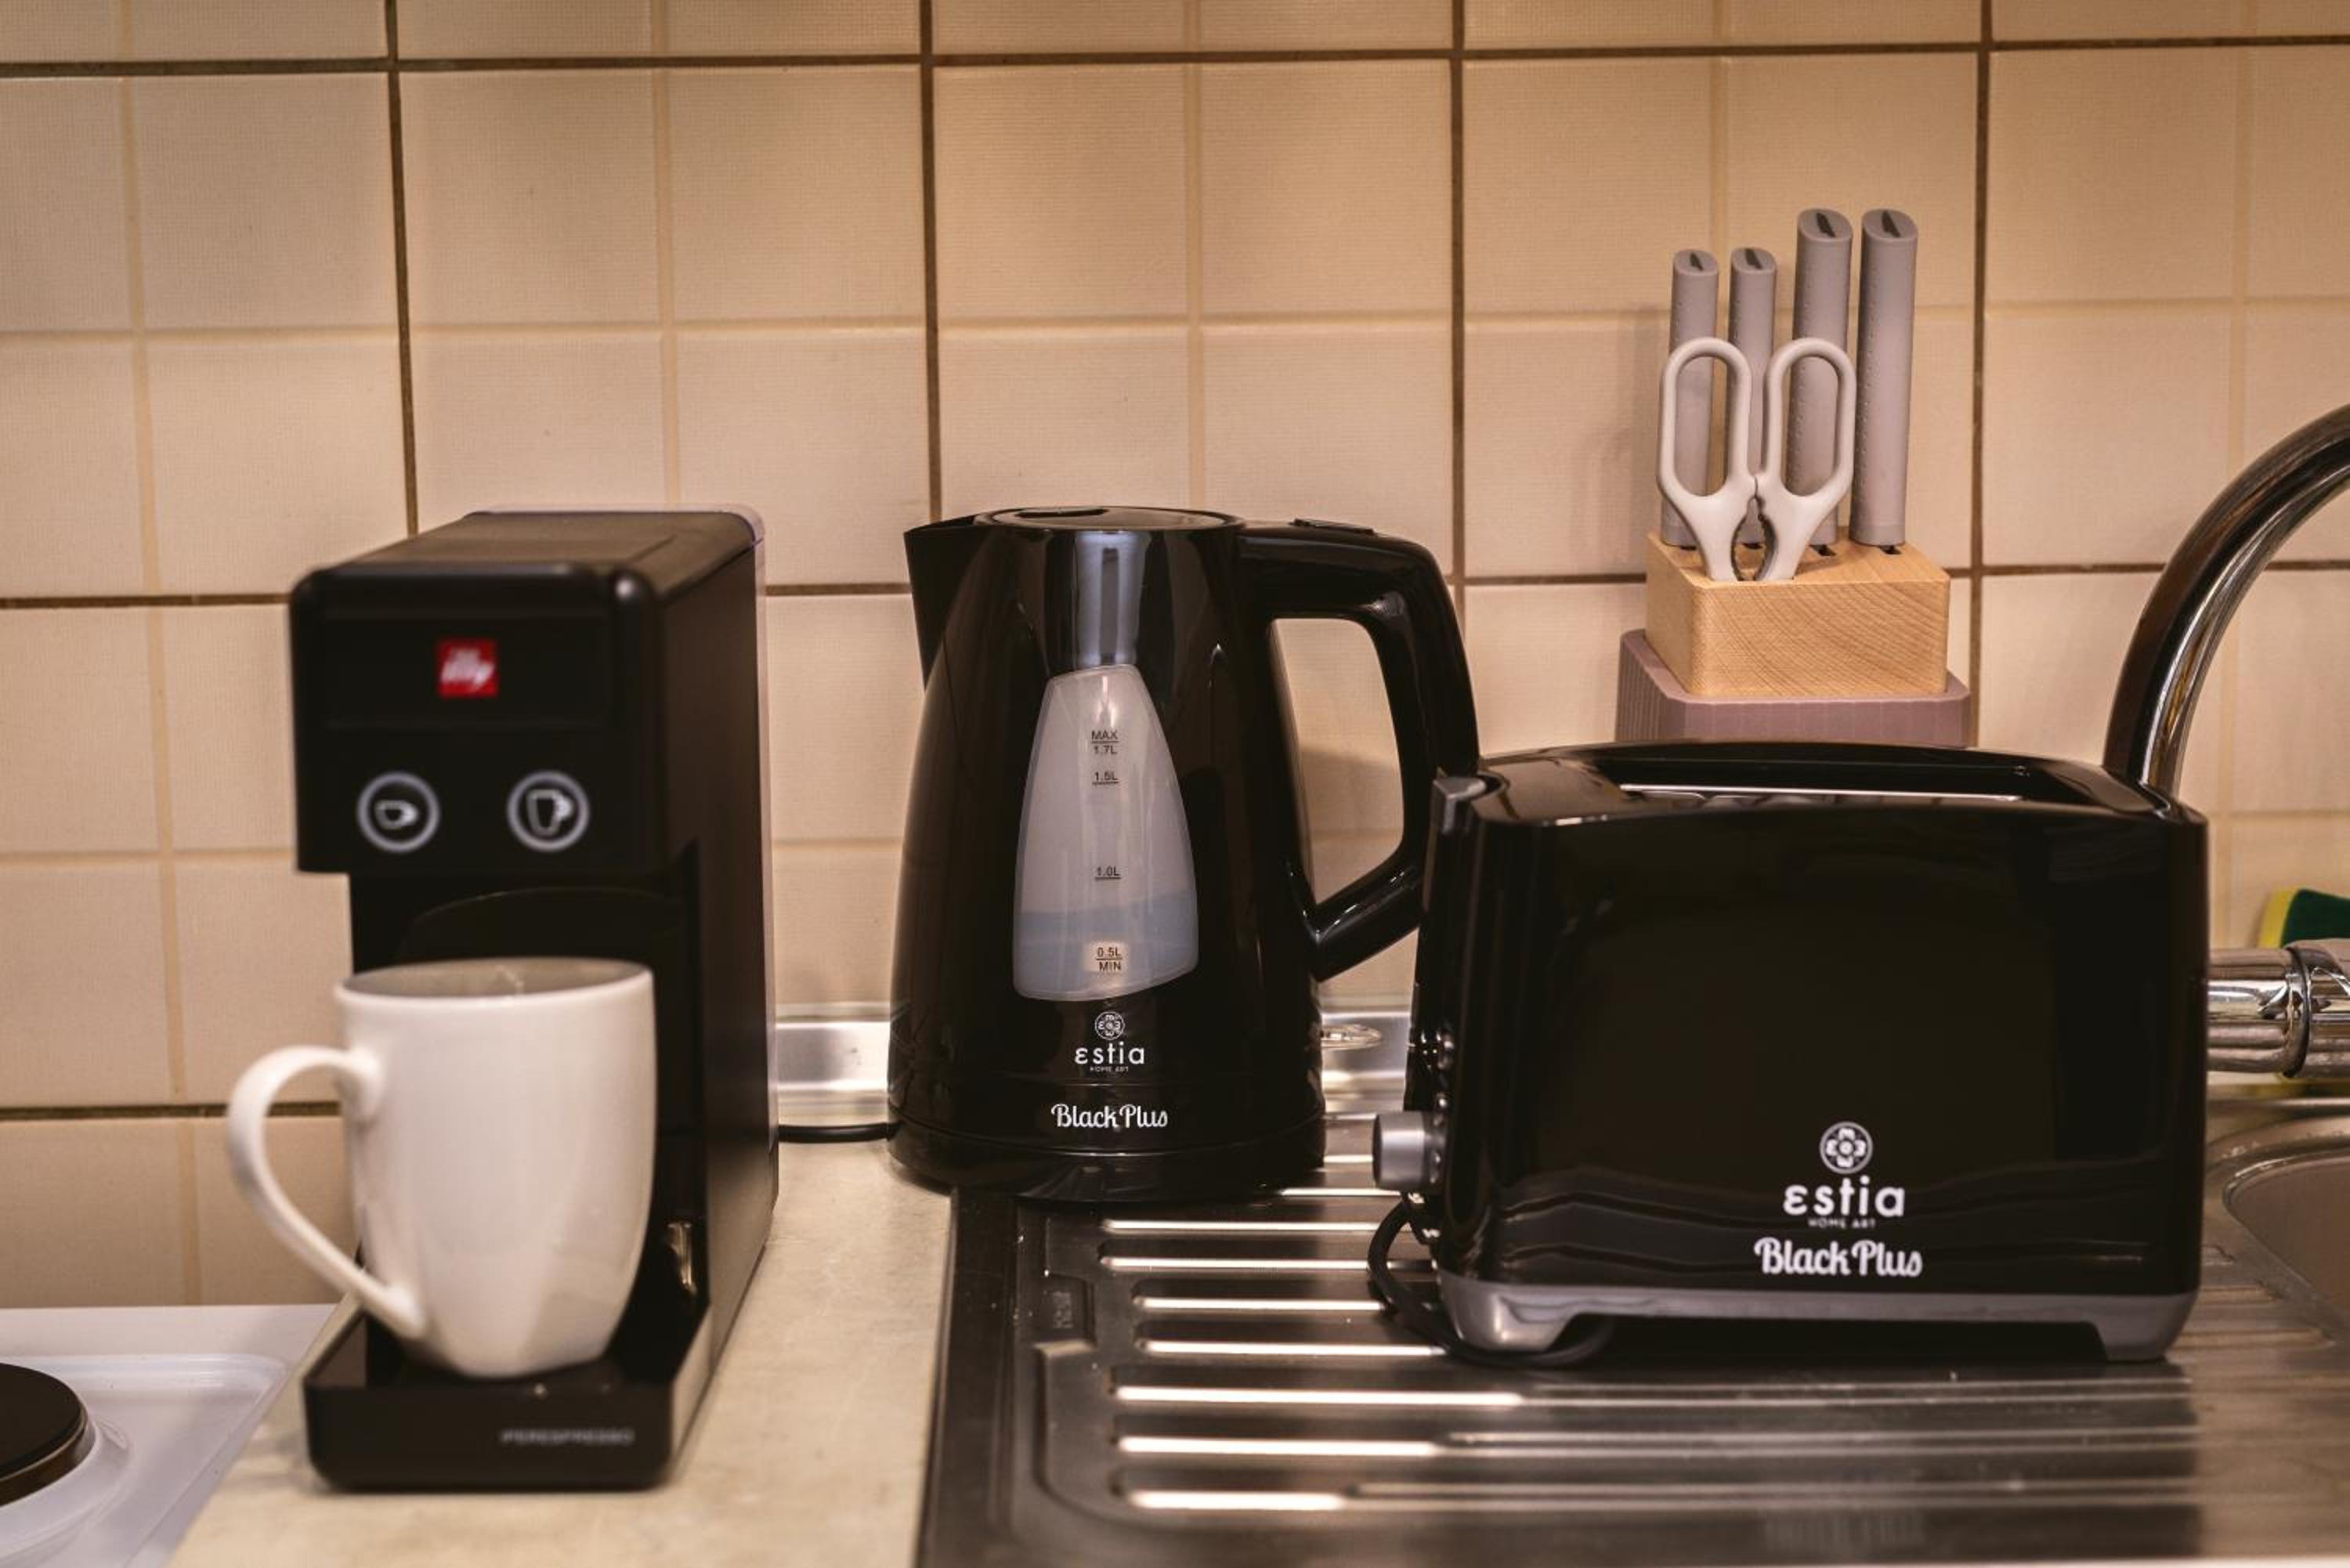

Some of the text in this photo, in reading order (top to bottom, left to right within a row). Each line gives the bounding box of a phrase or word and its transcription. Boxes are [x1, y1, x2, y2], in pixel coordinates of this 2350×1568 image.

[1091, 729, 1118, 740] MAX
[1097, 865, 1121, 876] 1.0L
[1099, 961, 1122, 971] MIN
[1807, 1218, 1876, 1229] HOME ART
